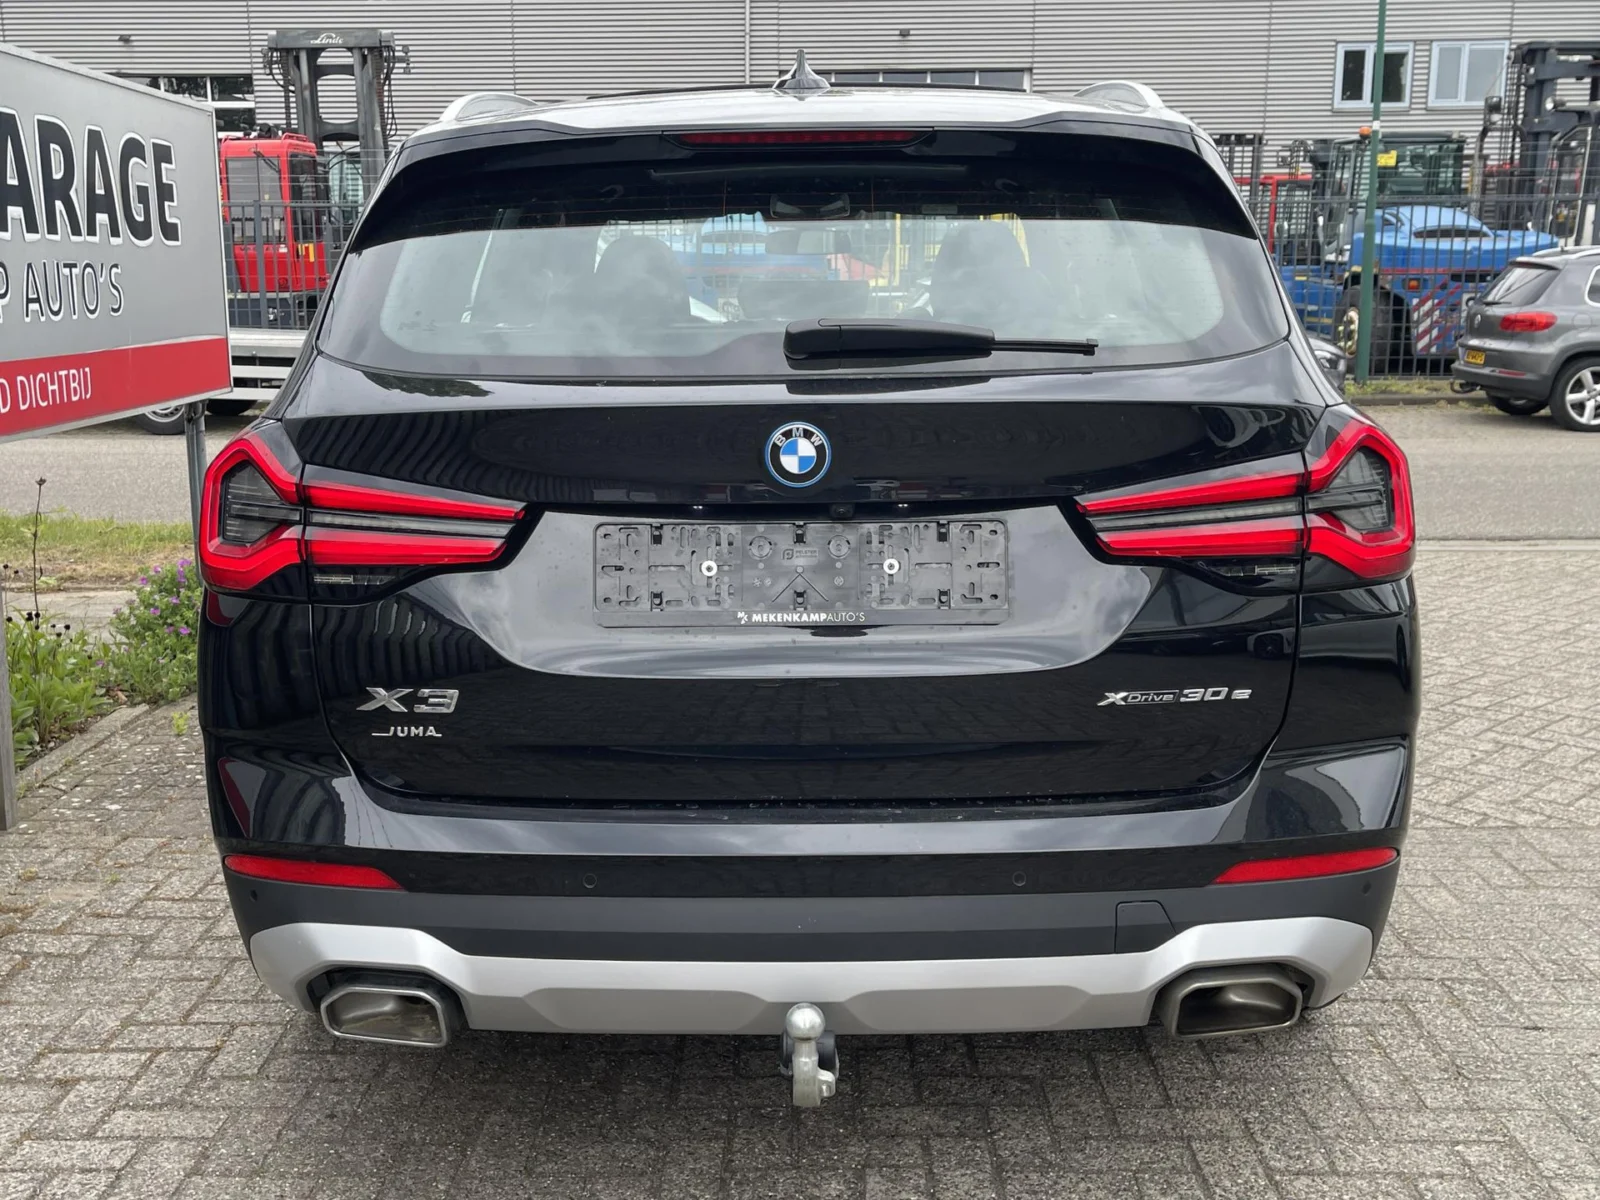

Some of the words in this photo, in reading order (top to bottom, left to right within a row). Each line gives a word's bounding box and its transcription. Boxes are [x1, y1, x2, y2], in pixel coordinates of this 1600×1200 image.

[310, 32, 344, 44] Linde
[0, 107, 181, 247] ARAGE
[23, 260, 124, 323] AUTO'S
[16, 367, 92, 411] DICHTBIJ
[774, 427, 823, 447] BMW
[356, 687, 459, 713] X3
